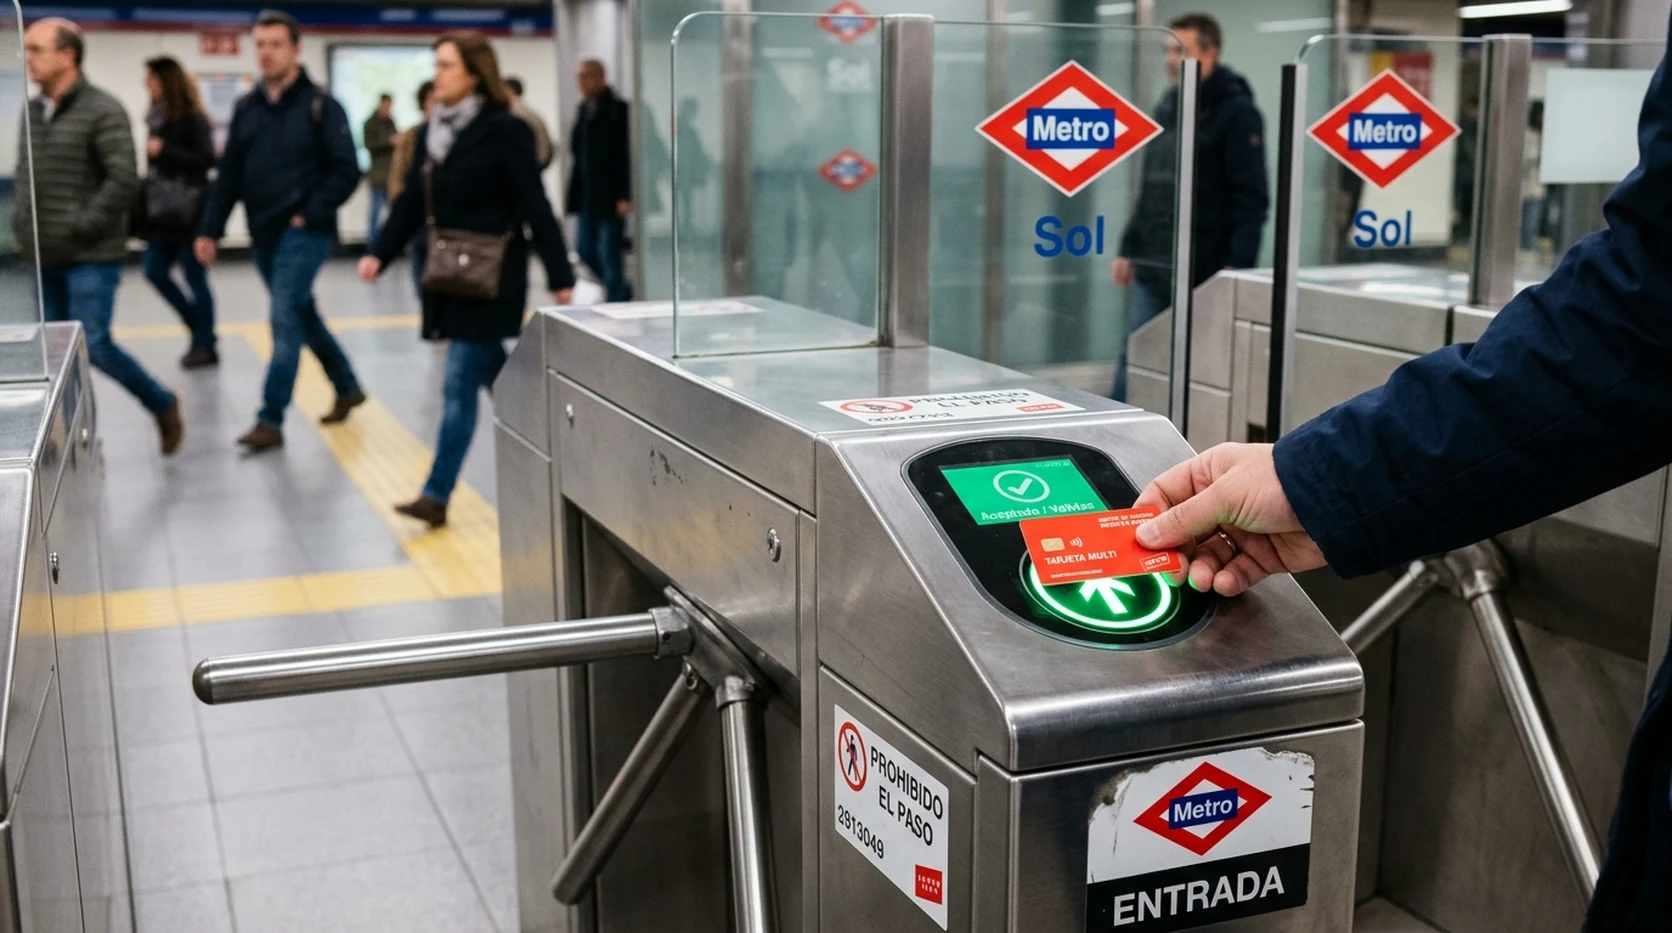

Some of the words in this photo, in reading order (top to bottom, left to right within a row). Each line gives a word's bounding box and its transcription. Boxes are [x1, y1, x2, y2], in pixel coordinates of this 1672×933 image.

[1033, 115, 1110, 142] Metro
[1353, 119, 1417, 143] Metro
[1034, 215, 1104, 258] Sol
[1354, 210, 1411, 248] Sol
[1044, 553, 1086, 565] TARJETA
[1087, 550, 1118, 561] MULTI
[871, 746, 943, 820] PROHIBIDO
[879, 785, 895, 817] EL
[898, 800, 933, 846] PASO
[1173, 799, 1233, 823] Metro
[1113, 865, 1285, 927] ENTRADA
